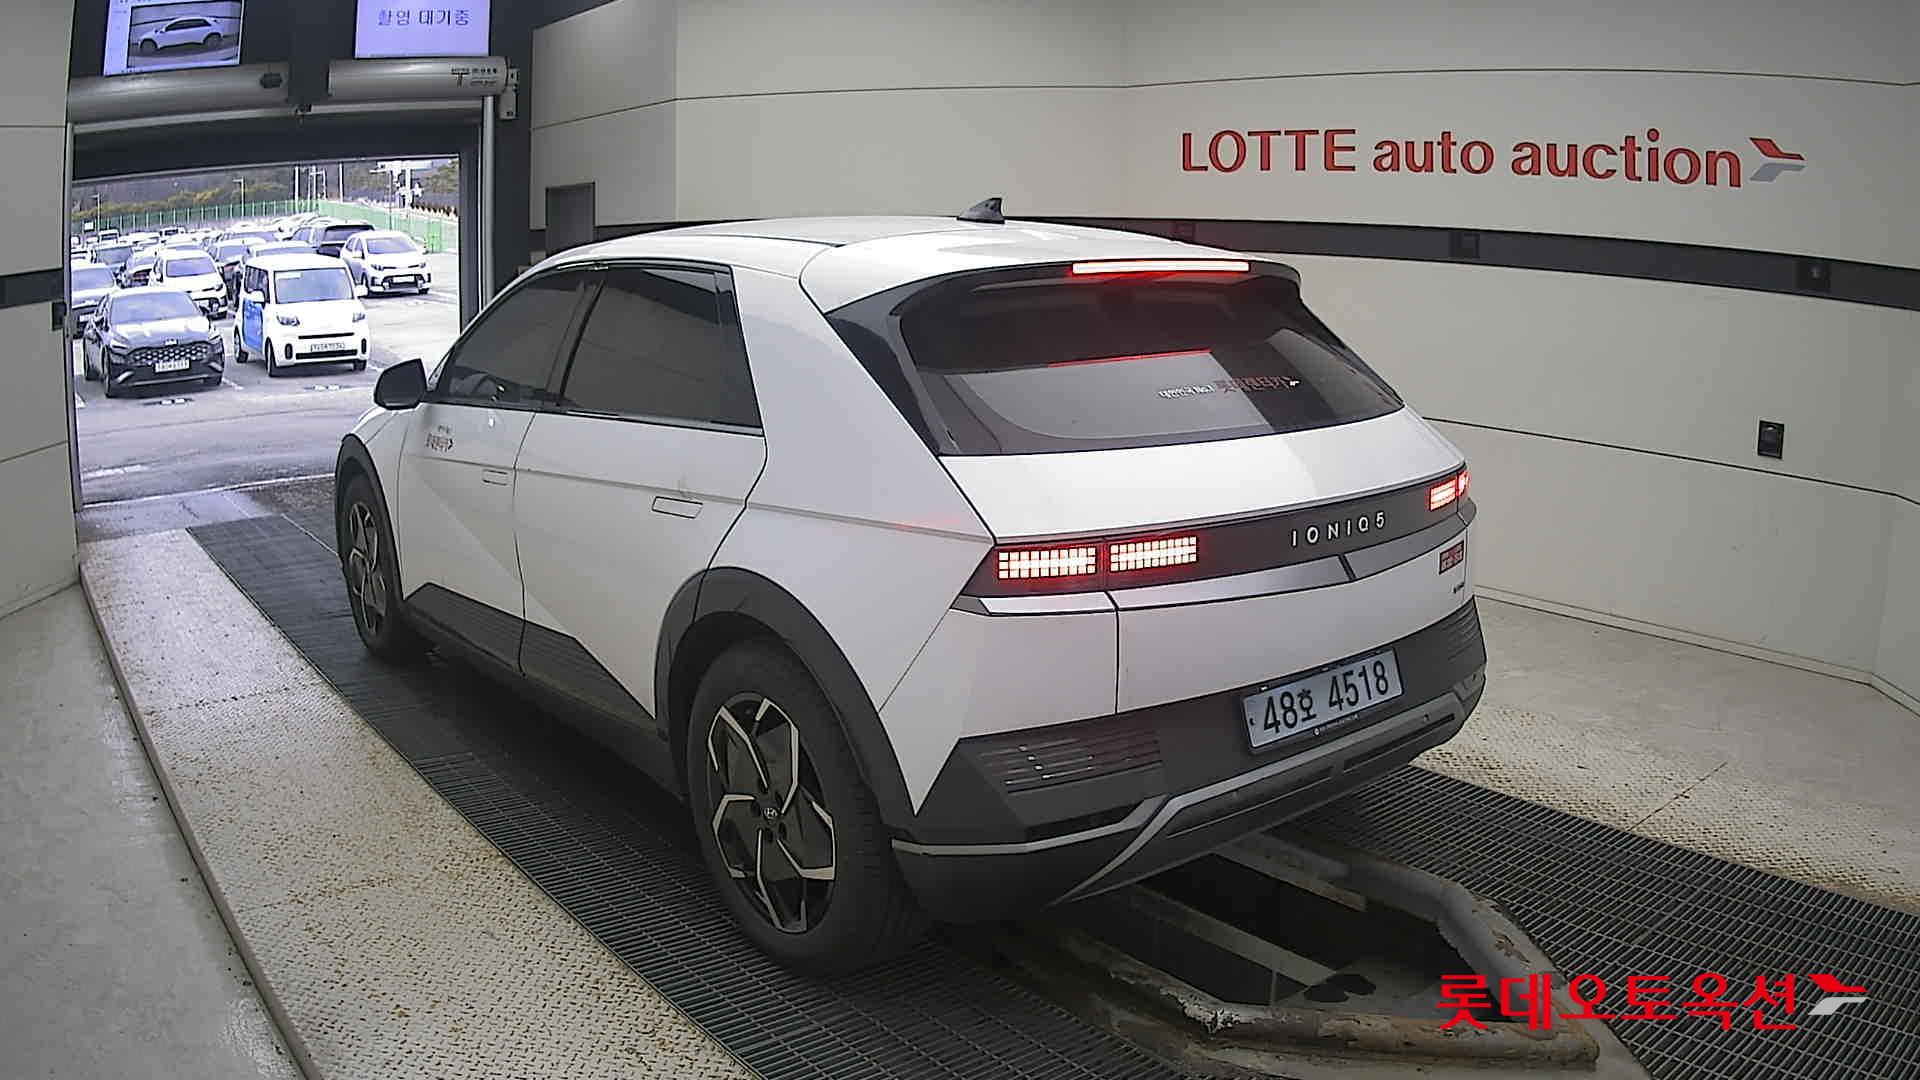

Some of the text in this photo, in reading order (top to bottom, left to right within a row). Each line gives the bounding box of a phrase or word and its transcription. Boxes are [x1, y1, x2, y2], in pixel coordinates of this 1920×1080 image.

[419, 9, 471, 26] 대기중
[1182, 128, 1742, 188] LOTTE auto auction
[1263, 660, 1389, 734] 48호 4518
